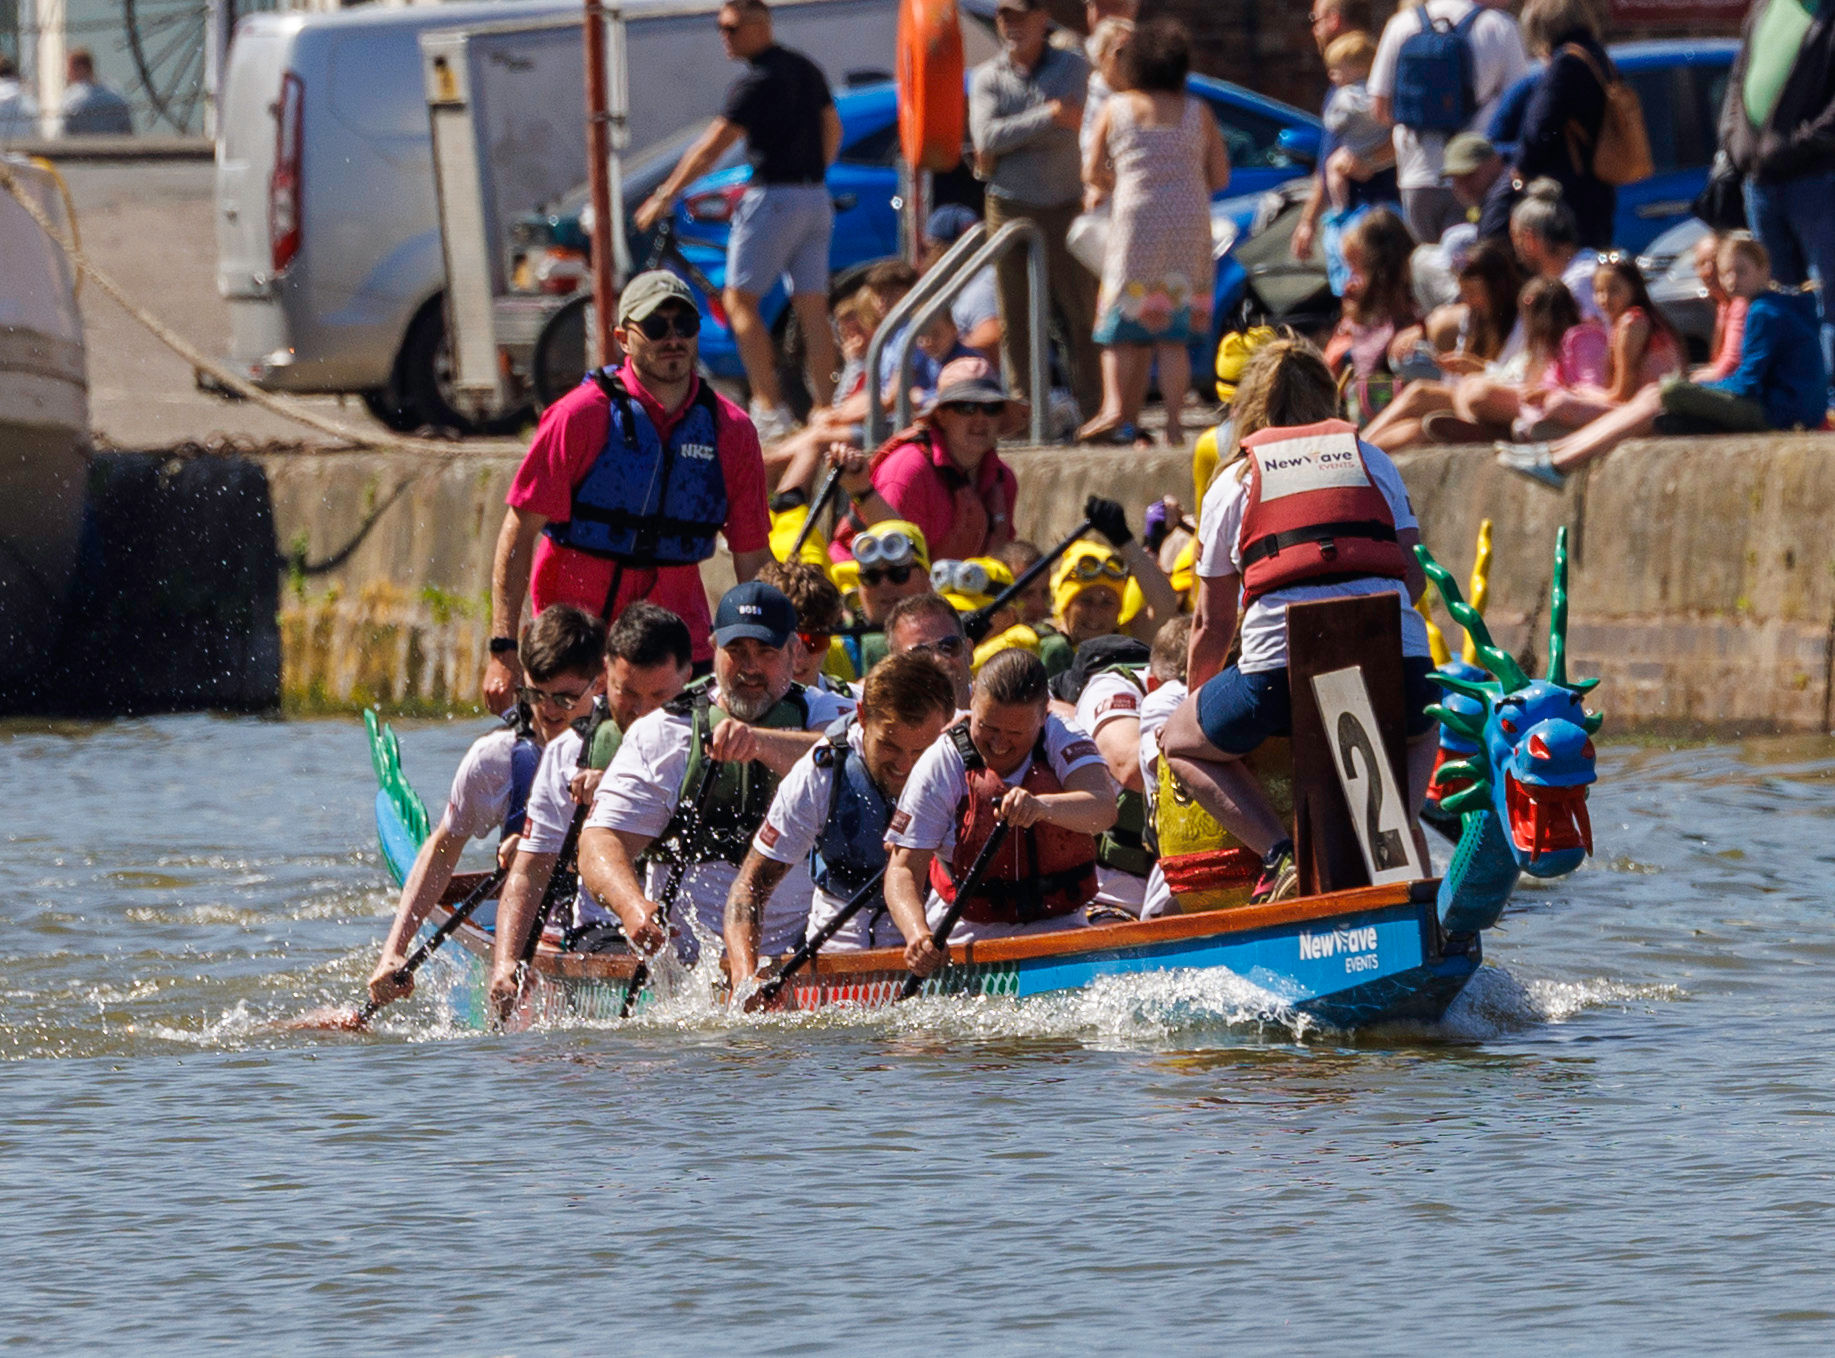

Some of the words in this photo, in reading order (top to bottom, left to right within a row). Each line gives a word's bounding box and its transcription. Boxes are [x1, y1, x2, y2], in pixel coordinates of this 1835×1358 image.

[1319, 461, 1356, 471] EVENTS
[1337, 711, 1410, 872] 2
[1345, 953, 1380, 974] EVENTS
